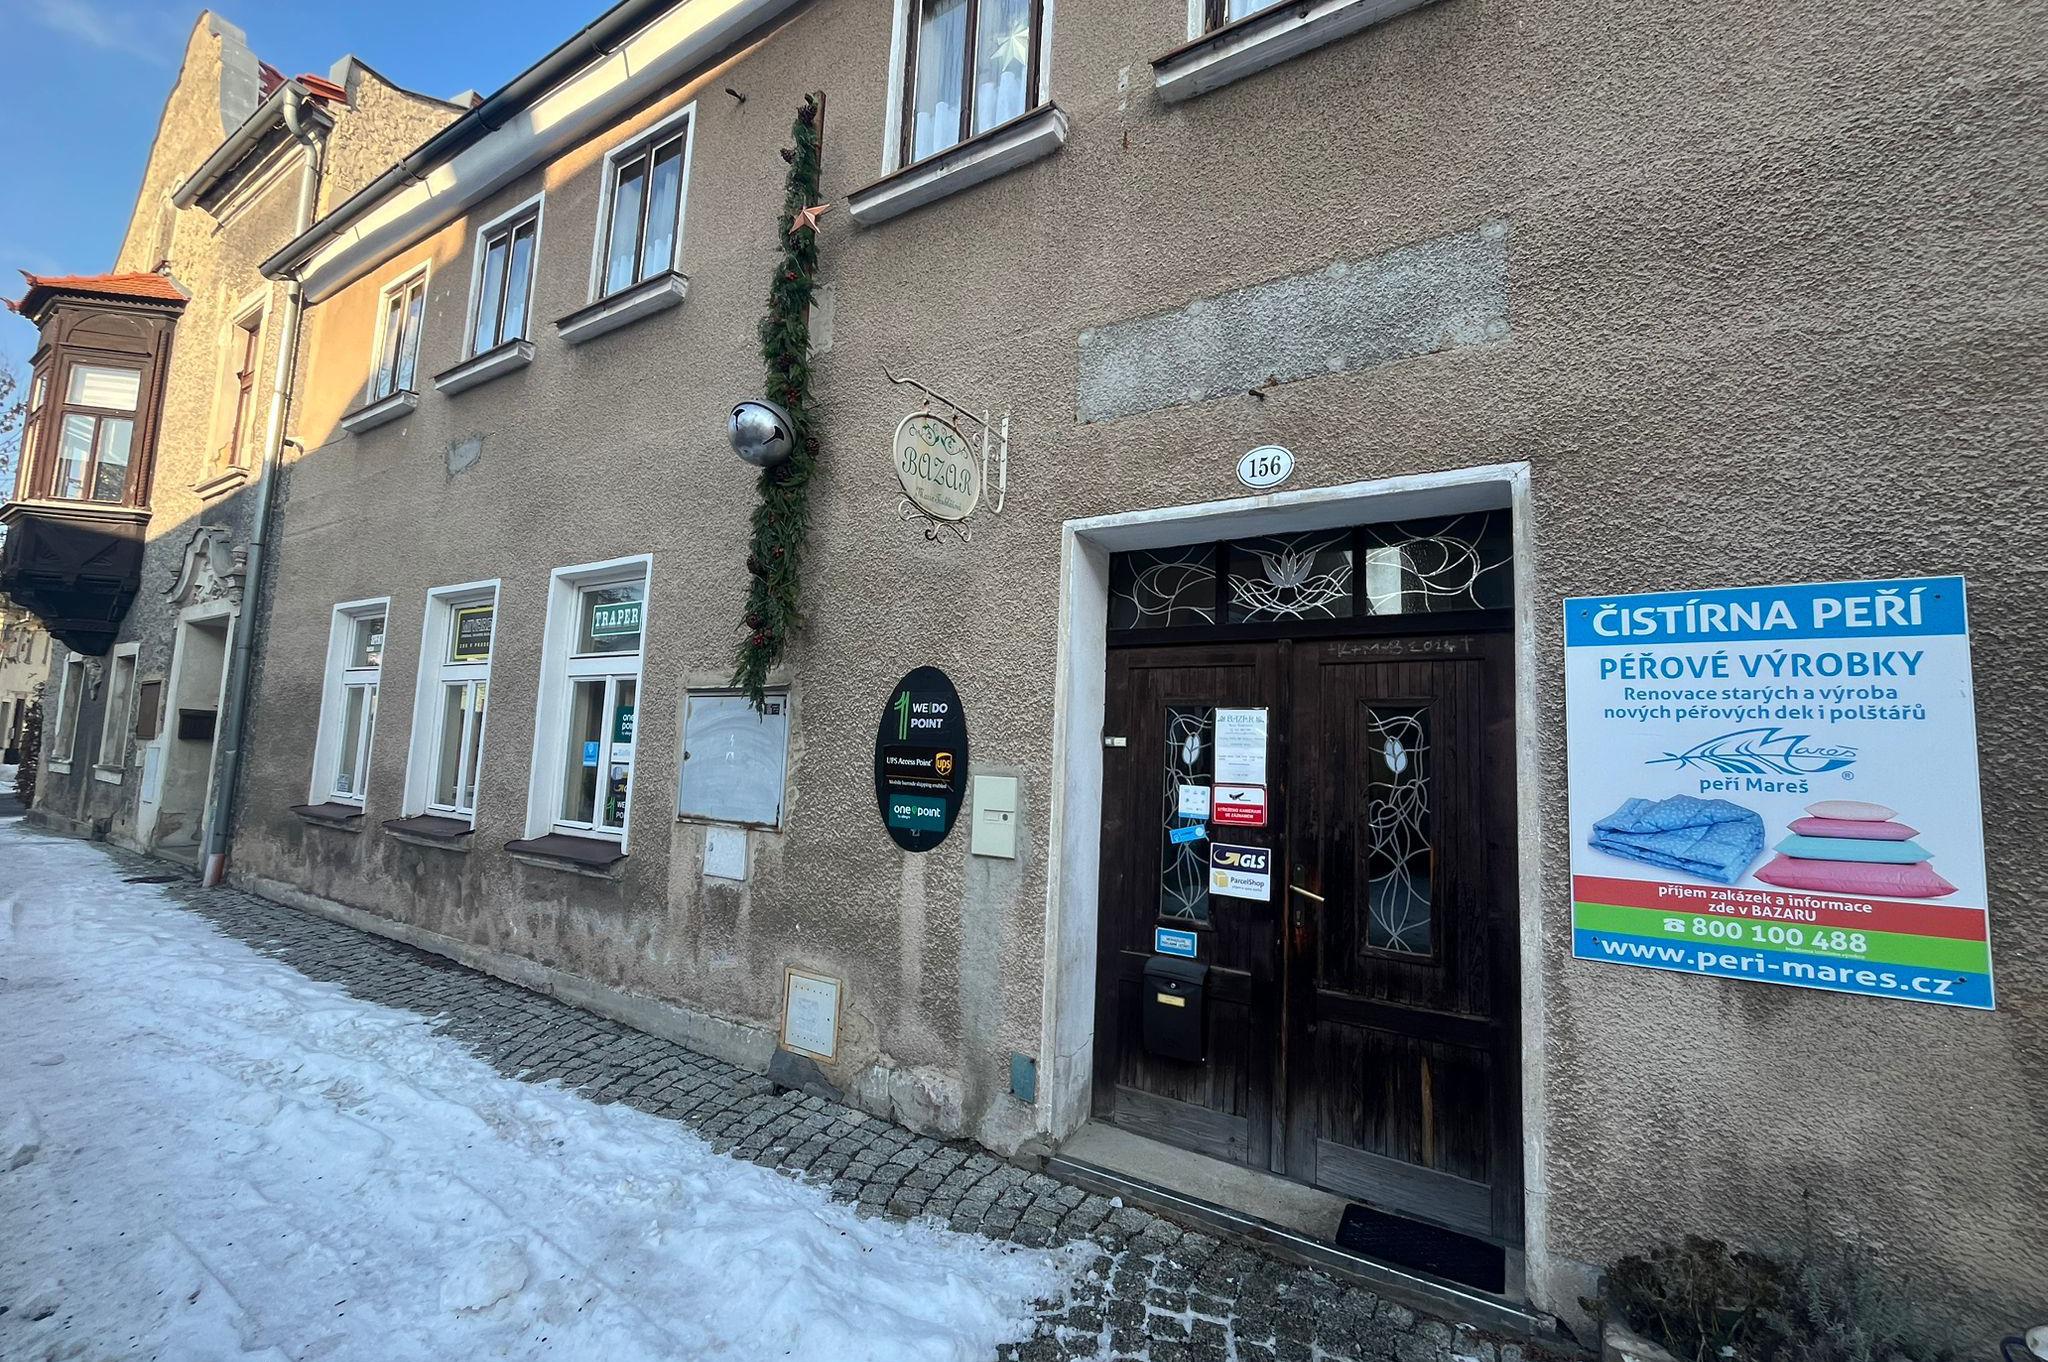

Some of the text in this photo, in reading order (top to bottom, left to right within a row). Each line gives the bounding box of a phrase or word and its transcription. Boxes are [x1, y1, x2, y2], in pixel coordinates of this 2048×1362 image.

[902, 447, 972, 496] BAZAR
[1249, 455, 1281, 478] 156
[595, 608, 639, 627] TRAPER
[1593, 587, 1927, 637] ČISTÍRNA PEŘÍ
[1601, 649, 1924, 680] PÉŘOVÉ VÝROBKY
[1625, 685, 1897, 703] Renovace starých a výroba
[1604, 704, 1926, 723] nových péřových dek i polštářů
[910, 718, 943, 729] POINT
[886, 756, 898, 765] UPS
[916, 758, 931, 767] Point
[937, 759, 951, 772] ups
[1700, 777, 1809, 793] peří Mareš
[893, 804, 912, 815] one
[917, 806, 941, 818] point
[1240, 854, 1266, 869] GLS
[1230, 876, 1265, 889] ParcelShop
[1658, 885, 1873, 913] příjem zakázek a informace
[1708, 902, 1817, 922] zde v BAZARU
[1692, 917, 1743, 940] 800
[1751, 925, 1803, 946] 100
[1811, 931, 1867, 953] 488
[1601, 938, 1954, 996] www.peri-mares.cz
